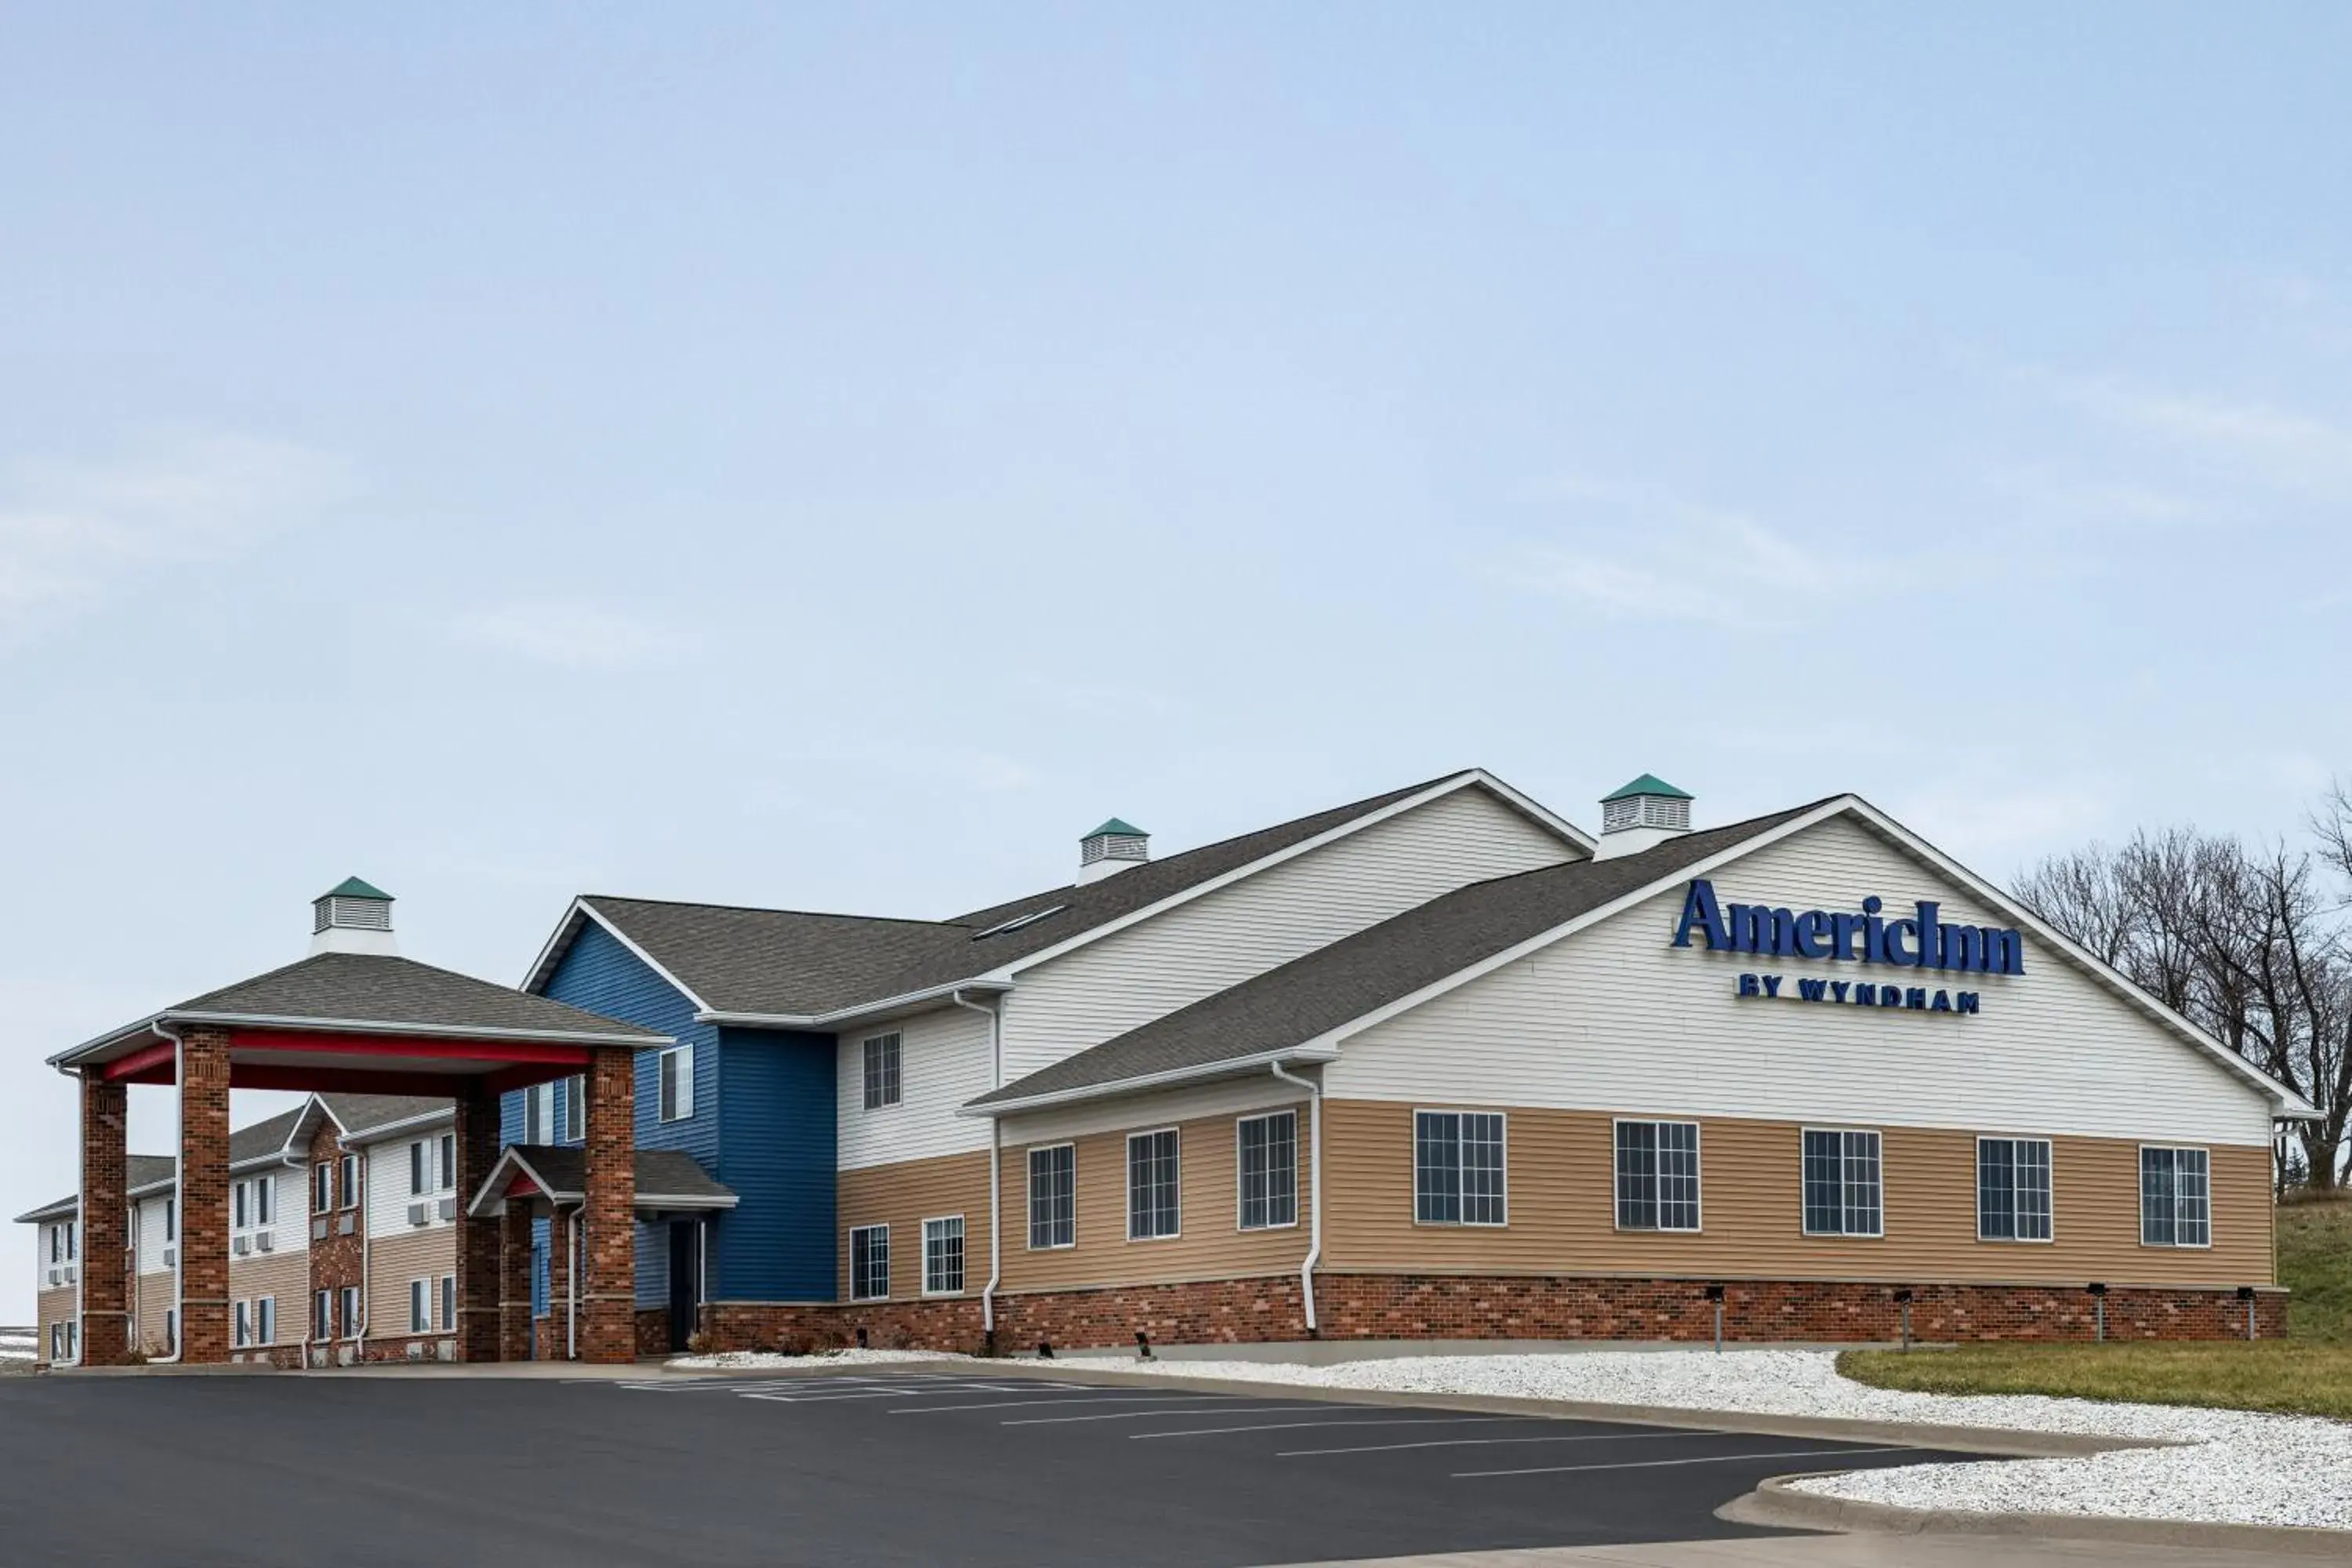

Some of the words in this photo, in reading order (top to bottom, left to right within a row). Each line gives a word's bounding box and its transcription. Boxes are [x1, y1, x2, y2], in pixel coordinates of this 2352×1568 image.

[1671, 879, 2025, 975] AmericInn
[1740, 974, 1782, 997] BY
[1799, 978, 1980, 1014] WYNDHAM
